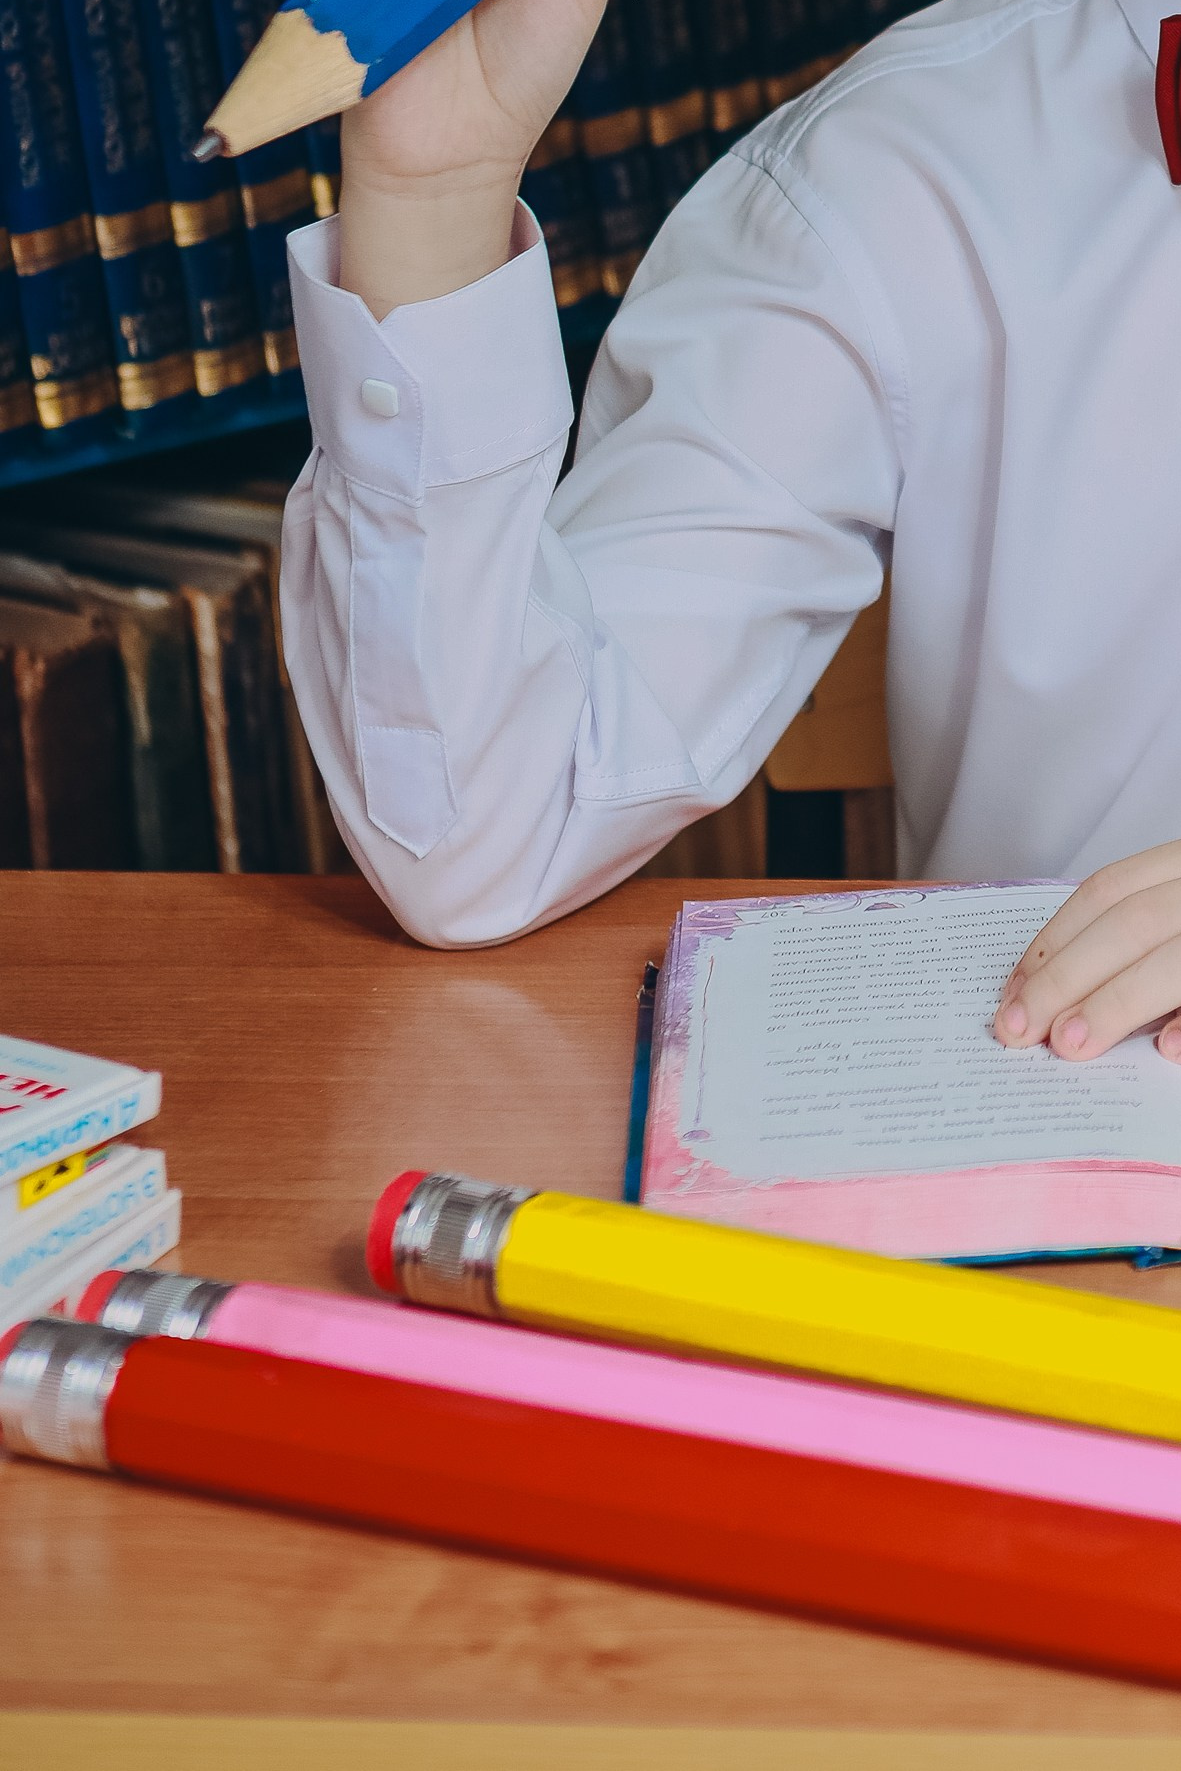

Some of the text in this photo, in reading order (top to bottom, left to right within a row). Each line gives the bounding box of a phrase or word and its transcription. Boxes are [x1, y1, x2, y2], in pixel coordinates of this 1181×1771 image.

[821, 919, 918, 930] собственным
[935, 917, 1049, 930] редполагалось,
[870, 930, 896, 938] они
[948, 932, 1005, 940] никогда
[774, 934, 861, 945] немедленно
[872, 940, 912, 948] видел
[774, 946, 861, 956] осколочных
[922, 955, 973, 963] такими
[976, 961, 1015, 969] ркал.
[770, 976, 860, 987] осколочные
[866, 979, 940, 988] огромное
[769, 985, 856, 997] количество
[838, 1003, 904, 1012] ужасном
[886, 1013, 939, 1021] только
[853, 1037, 943, 1046] осколочная
